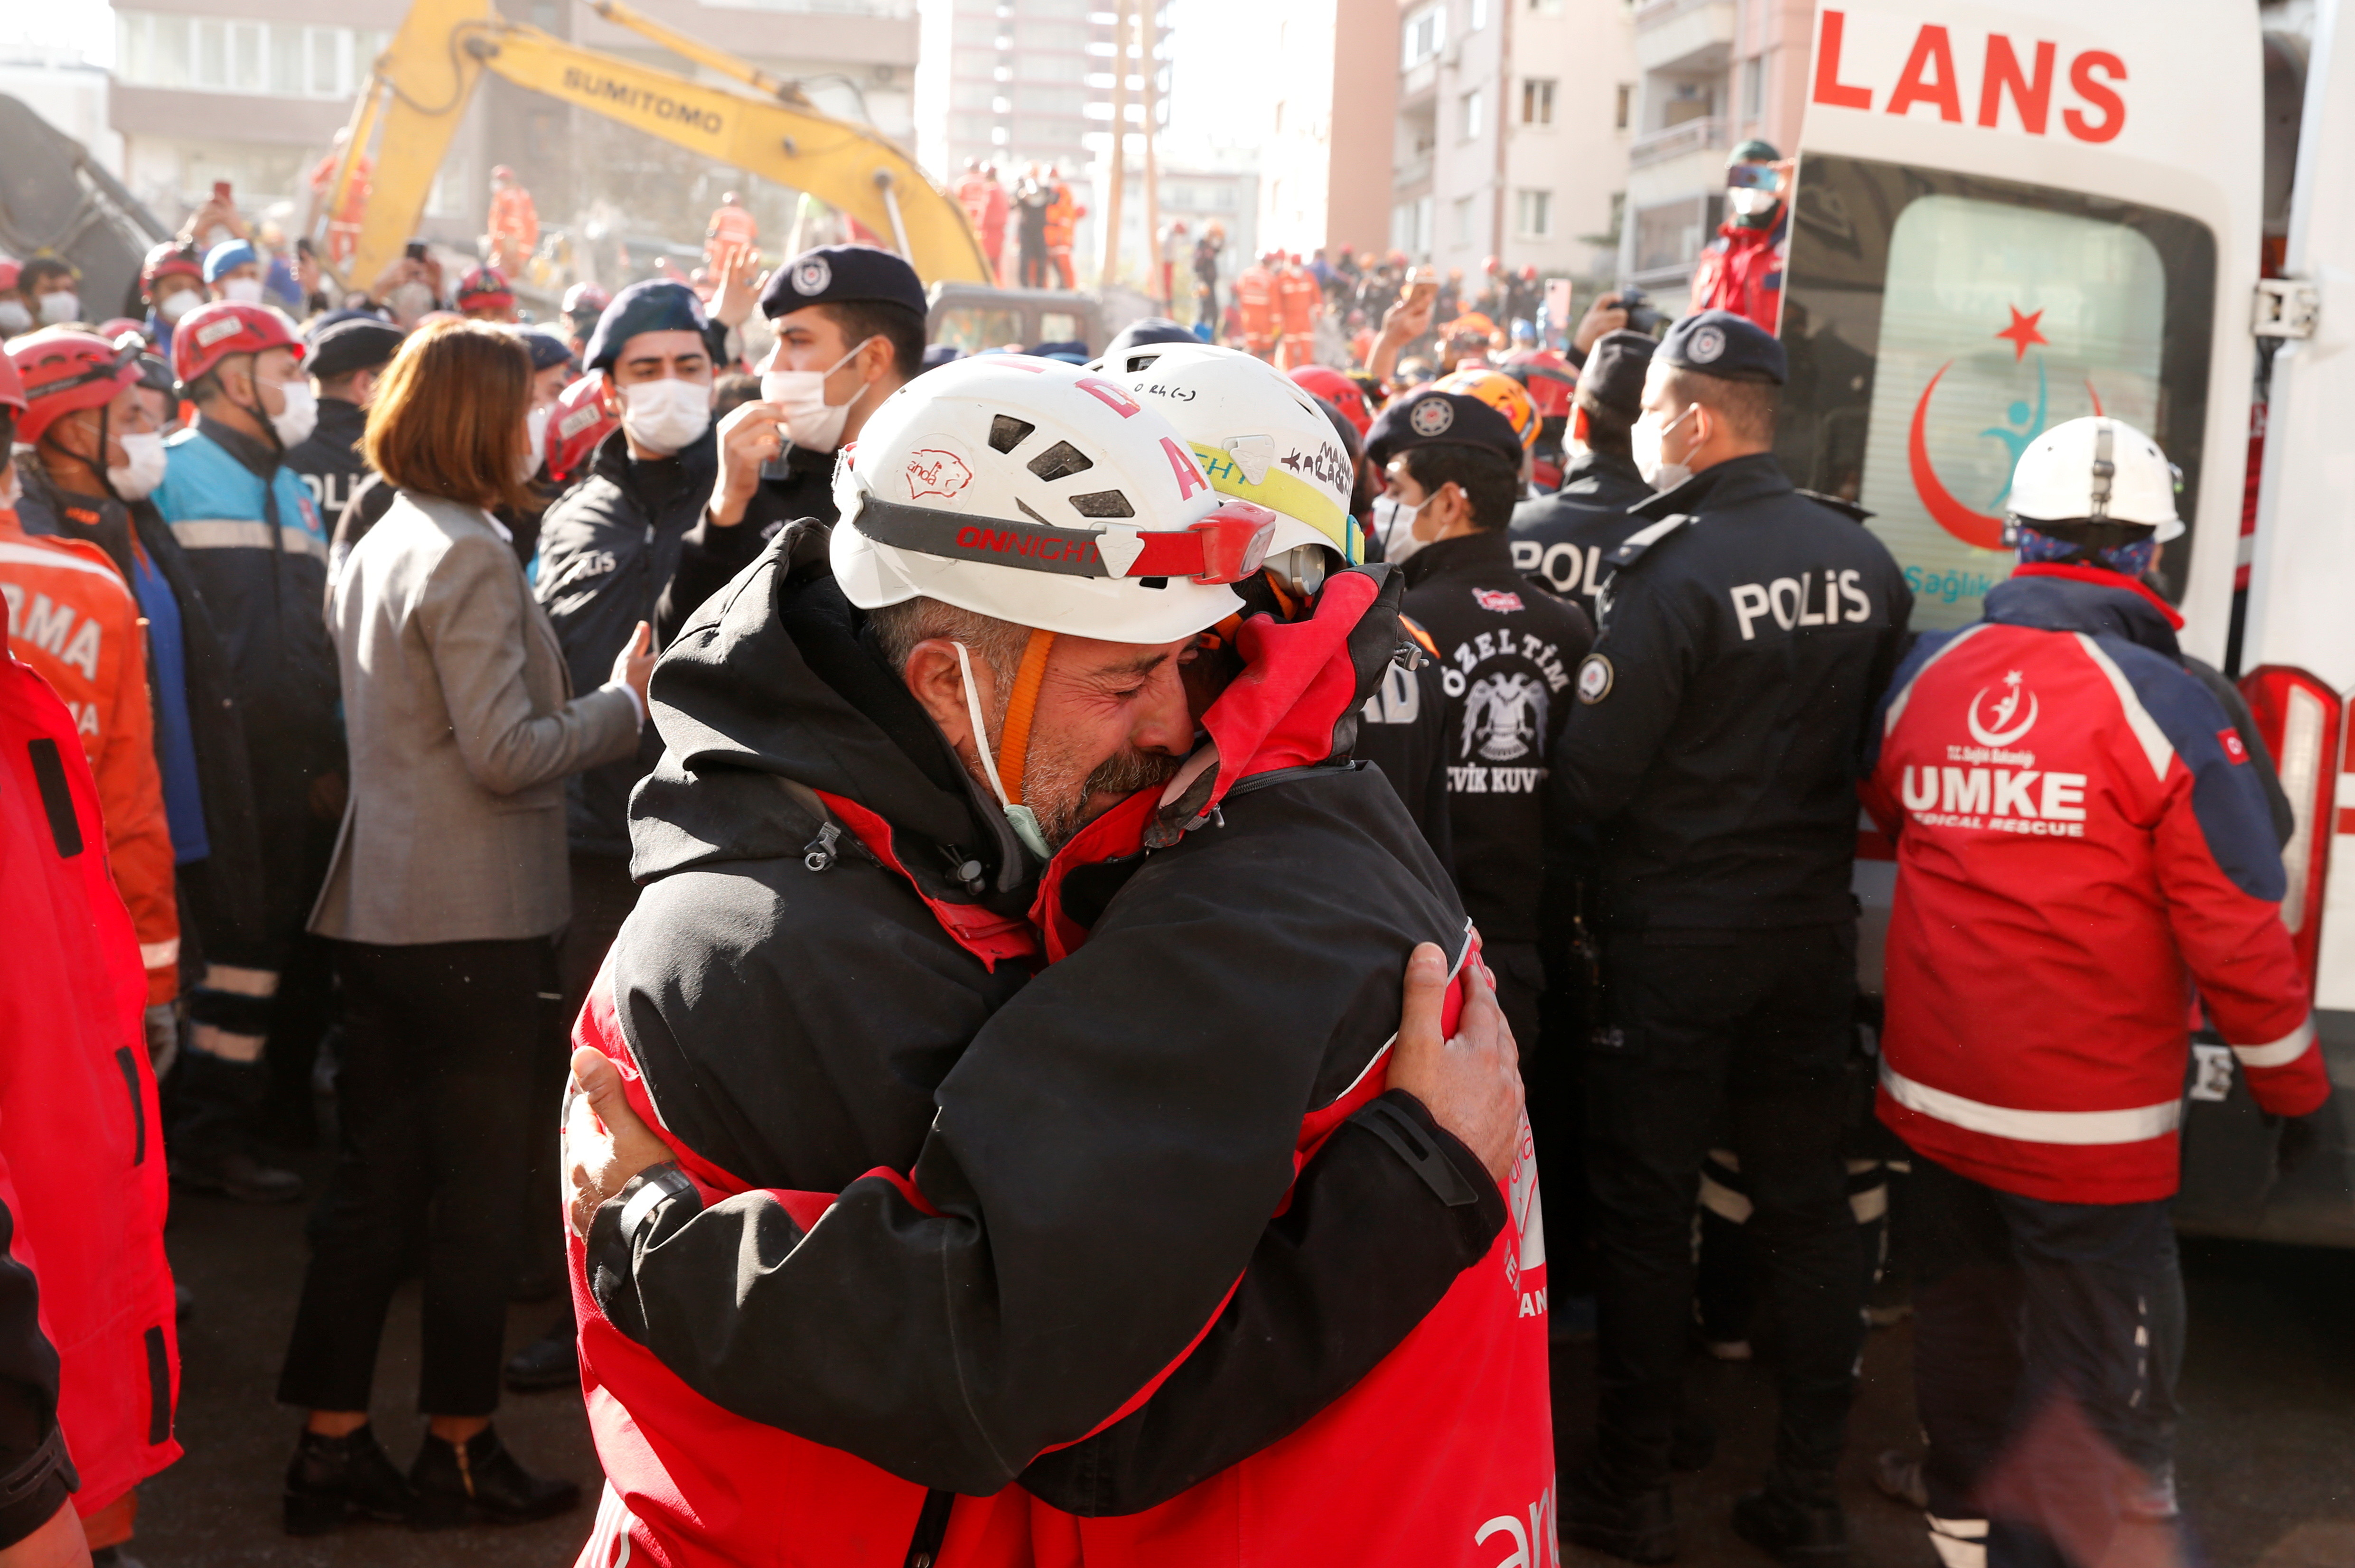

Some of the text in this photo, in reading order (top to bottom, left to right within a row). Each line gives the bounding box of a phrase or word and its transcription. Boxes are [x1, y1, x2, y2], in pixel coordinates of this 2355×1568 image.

[561, 65, 723, 135] SUMITOMO
[1813, 9, 2128, 143] LANS
[1439, 627, 1517, 698] ÖZEL
[1901, 764, 2088, 822] UMKE
[1989, 817, 2085, 838] RESCUE
